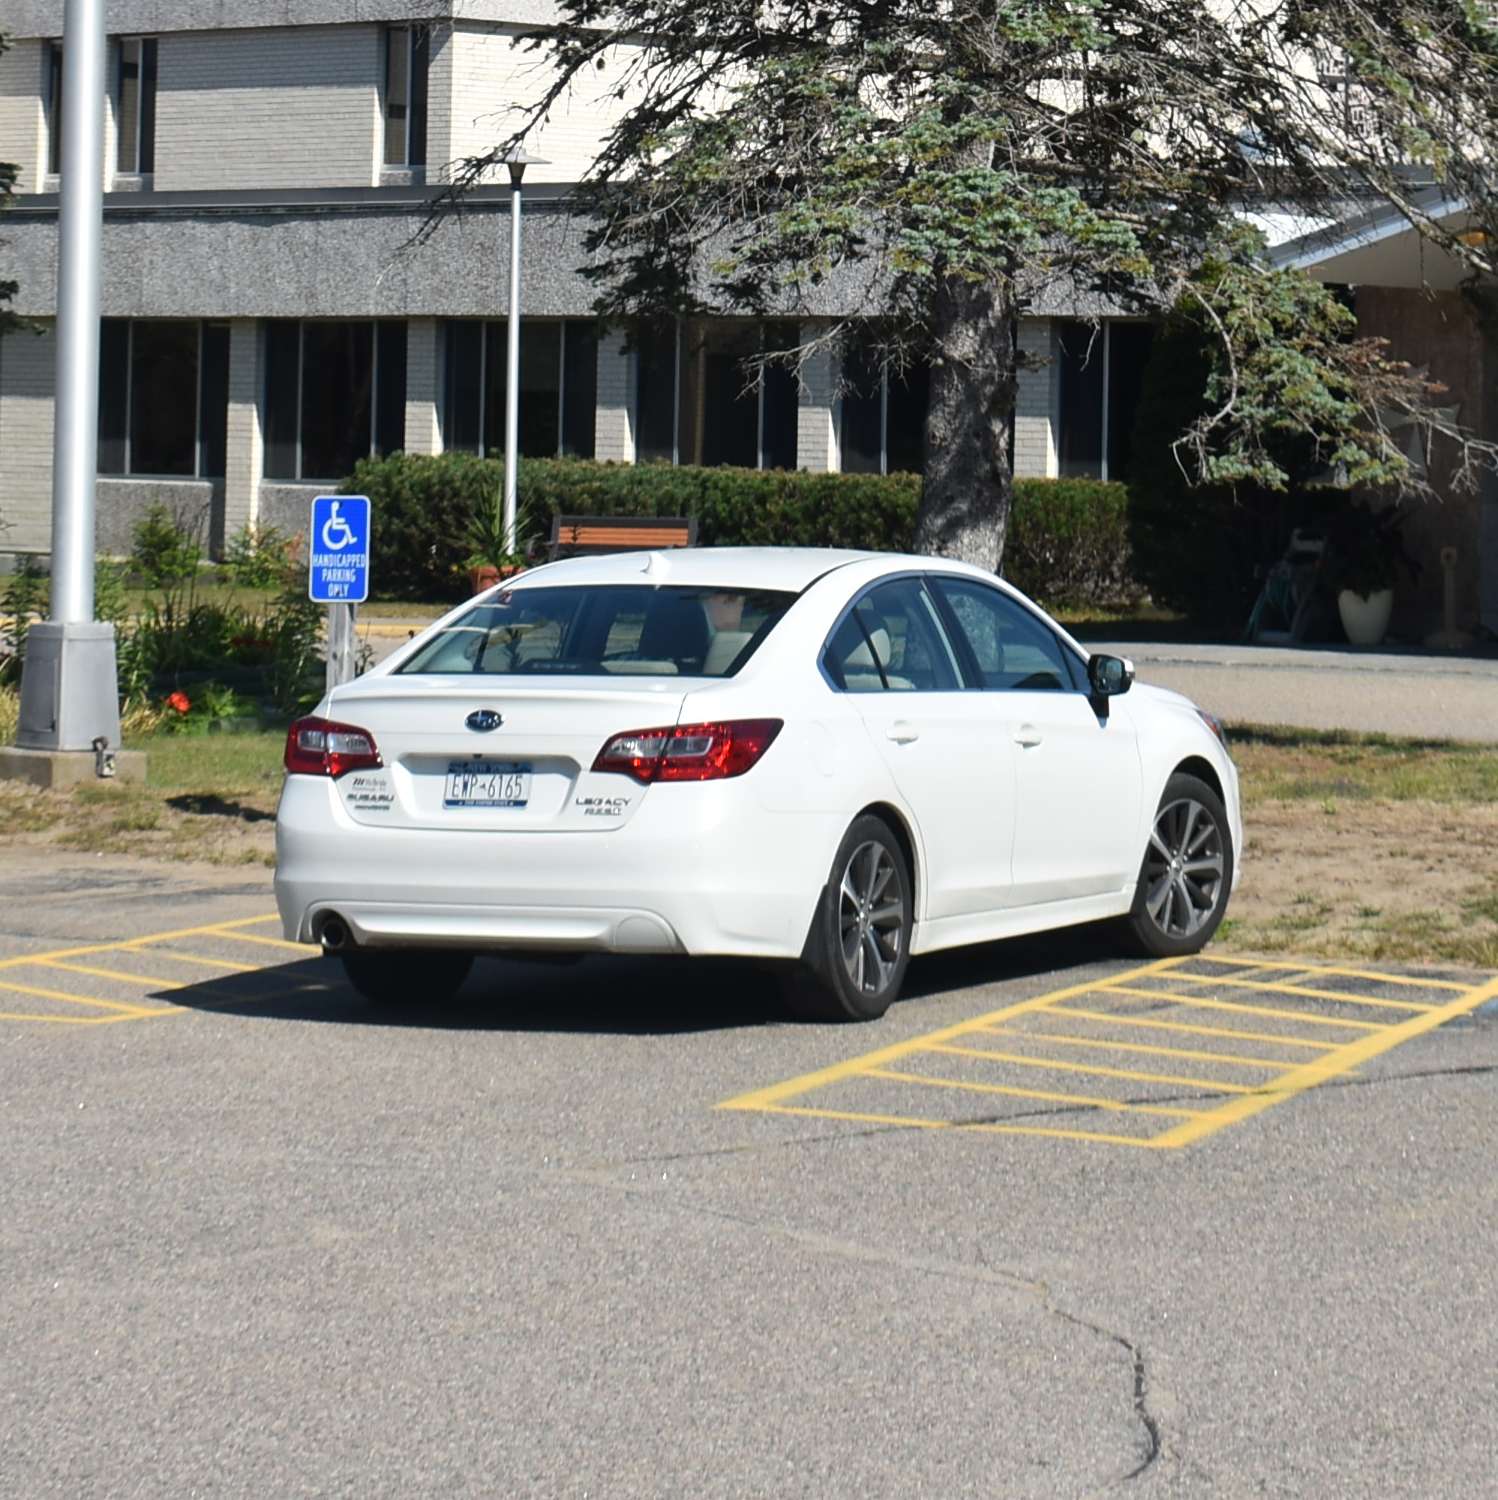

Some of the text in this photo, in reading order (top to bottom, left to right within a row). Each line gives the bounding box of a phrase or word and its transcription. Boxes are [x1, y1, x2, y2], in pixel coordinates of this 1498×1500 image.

[312, 553, 366, 568] HANDICAPPED
[321, 568, 356, 583] PARKING
[327, 583, 349, 597] ONLY
[346, 793, 395, 802] SUBARU
[575, 797, 632, 806] LEGACY
